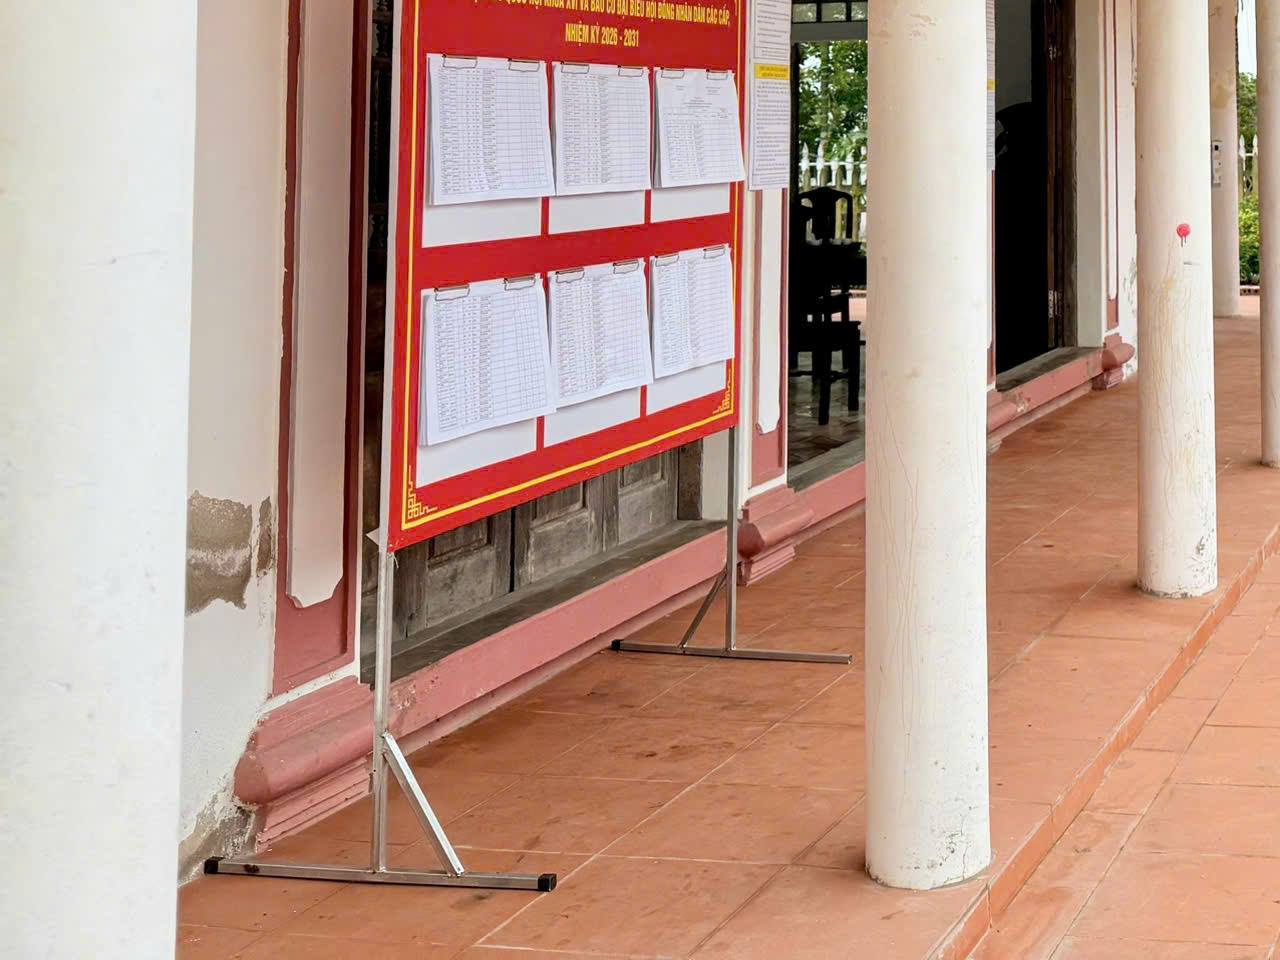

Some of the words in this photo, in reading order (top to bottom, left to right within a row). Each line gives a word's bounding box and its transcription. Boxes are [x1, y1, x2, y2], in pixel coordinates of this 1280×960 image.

[676, 2, 693, 23] NHÂN
[694, 3, 706, 23] DÂN
[706, 5, 717, 24] CÁC
[565, 20, 589, 46] NHIỆM
[591, 22, 600, 44] KỲ
[601, 27, 618, 46] 2026
[624, 29, 639, 47] 2031
